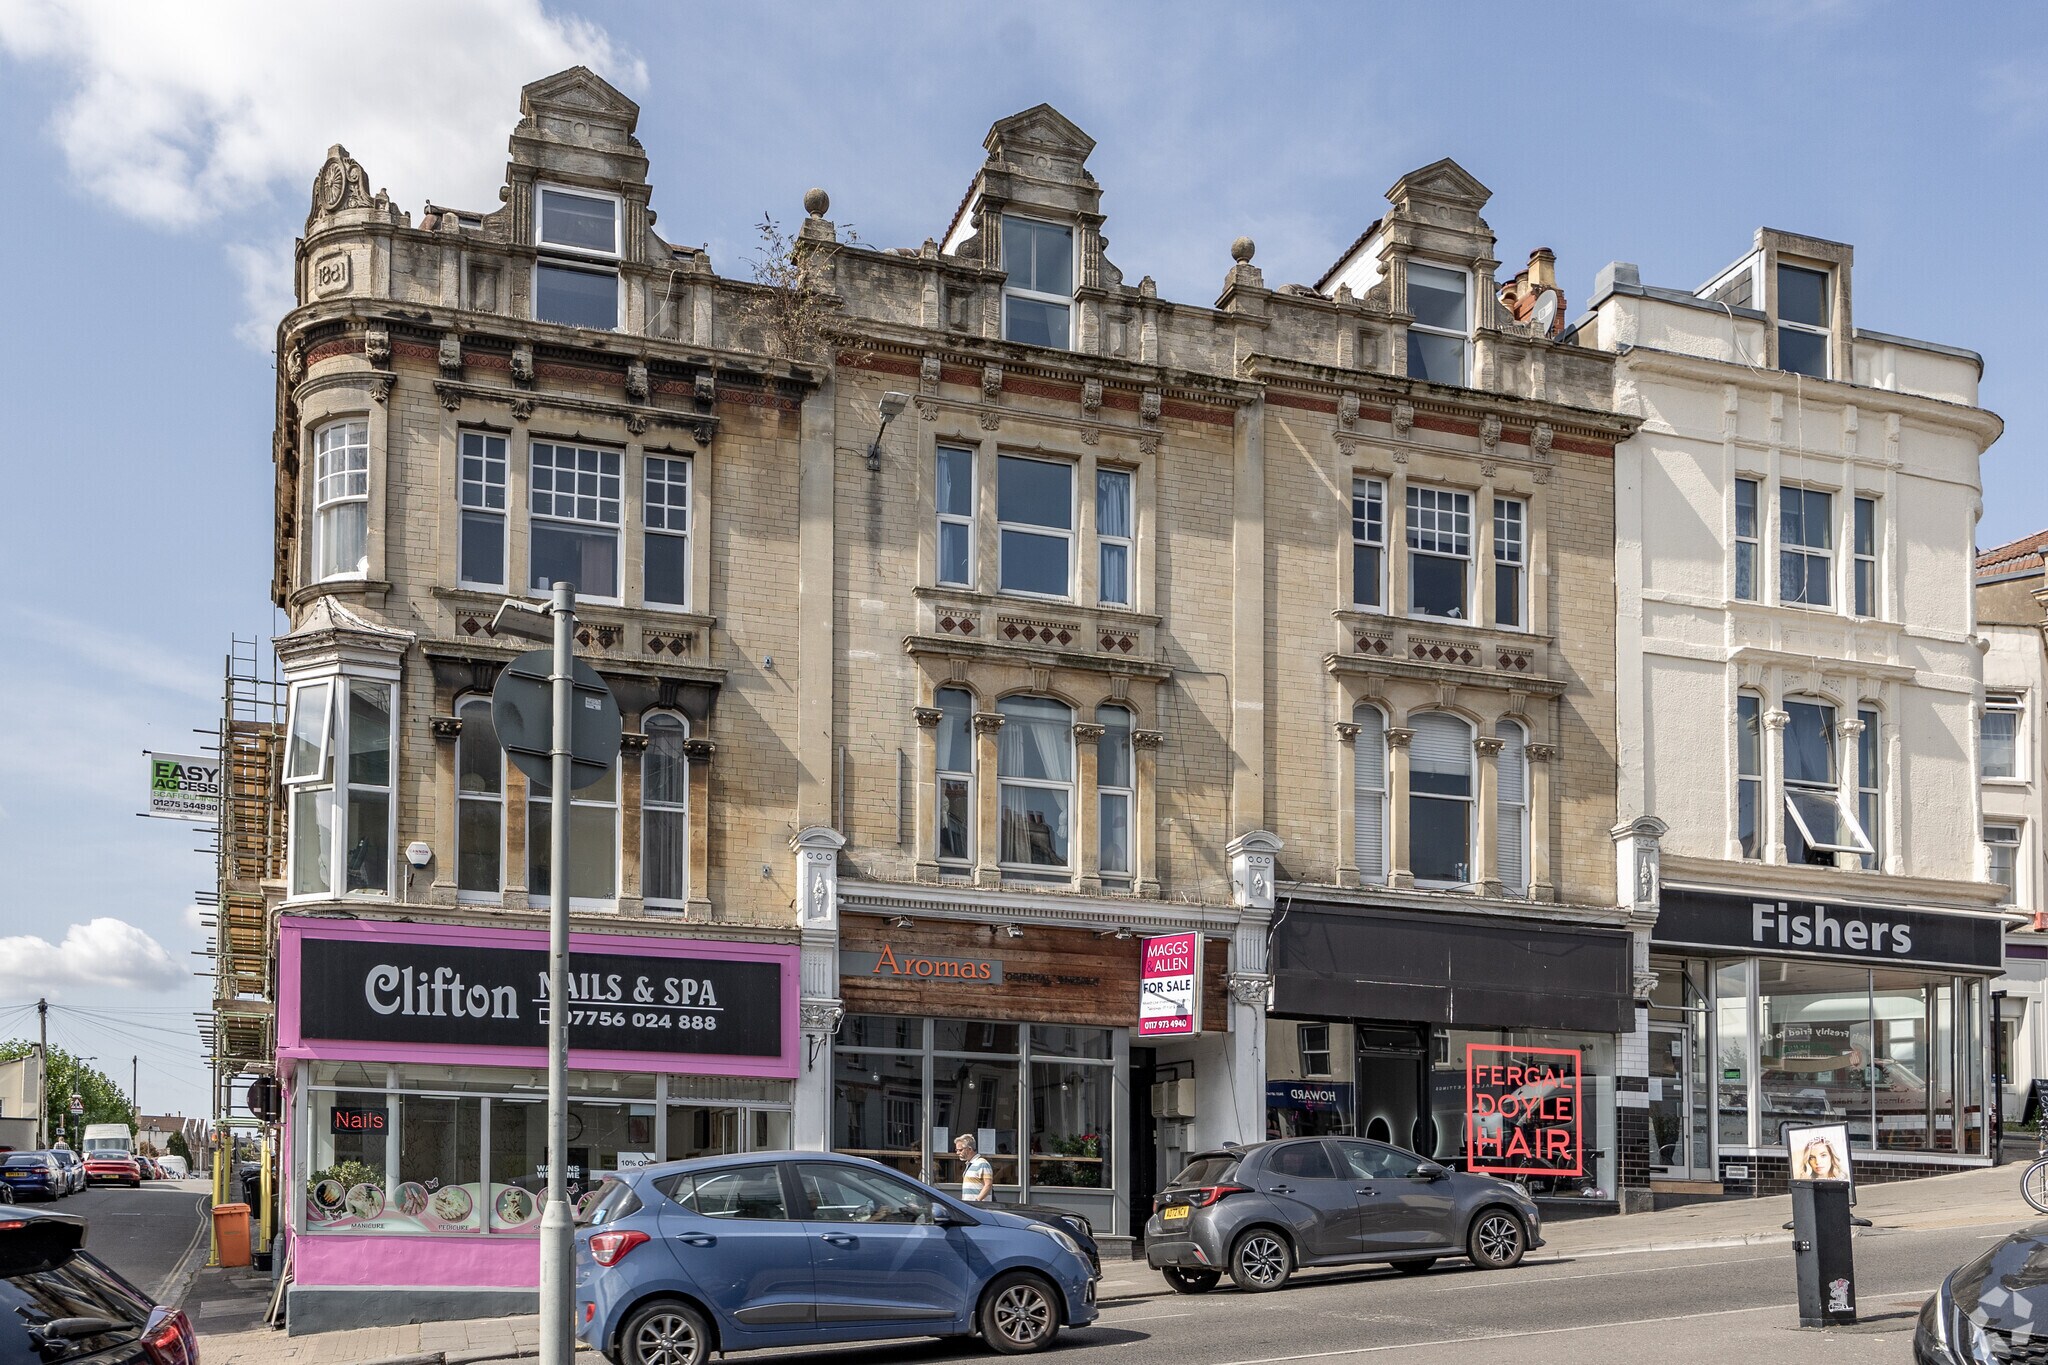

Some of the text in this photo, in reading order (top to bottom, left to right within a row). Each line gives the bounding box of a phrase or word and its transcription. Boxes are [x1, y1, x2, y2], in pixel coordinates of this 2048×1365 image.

[155, 762, 220, 782] EASY
[154, 778, 218, 794] ACCESS
[153, 790, 218, 802] SCAFFOLDING
[153, 799, 180, 808] 01275
[183, 802, 218, 812] 544990
[1752, 902, 1912, 954] Fishers
[1147, 940, 1188, 958] MAGGS
[872, 943, 991, 980] Aromas
[365, 964, 520, 1019] Clifton
[633, 976, 654, 1003] &
[664, 977, 717, 1006] SPA
[1144, 980, 1190, 994] FOR SALE
[632, 1012, 672, 1029] 024
[678, 1014, 717, 1030] 888
[1144, 1020, 1187, 1030] 0117 973 4940
[1475, 1064, 1572, 1089] FERGAL
[1475, 1093, 1572, 1121] DOYLE
[336, 1111, 384, 1128] Nails
[1477, 1126, 1572, 1160] HAIR
